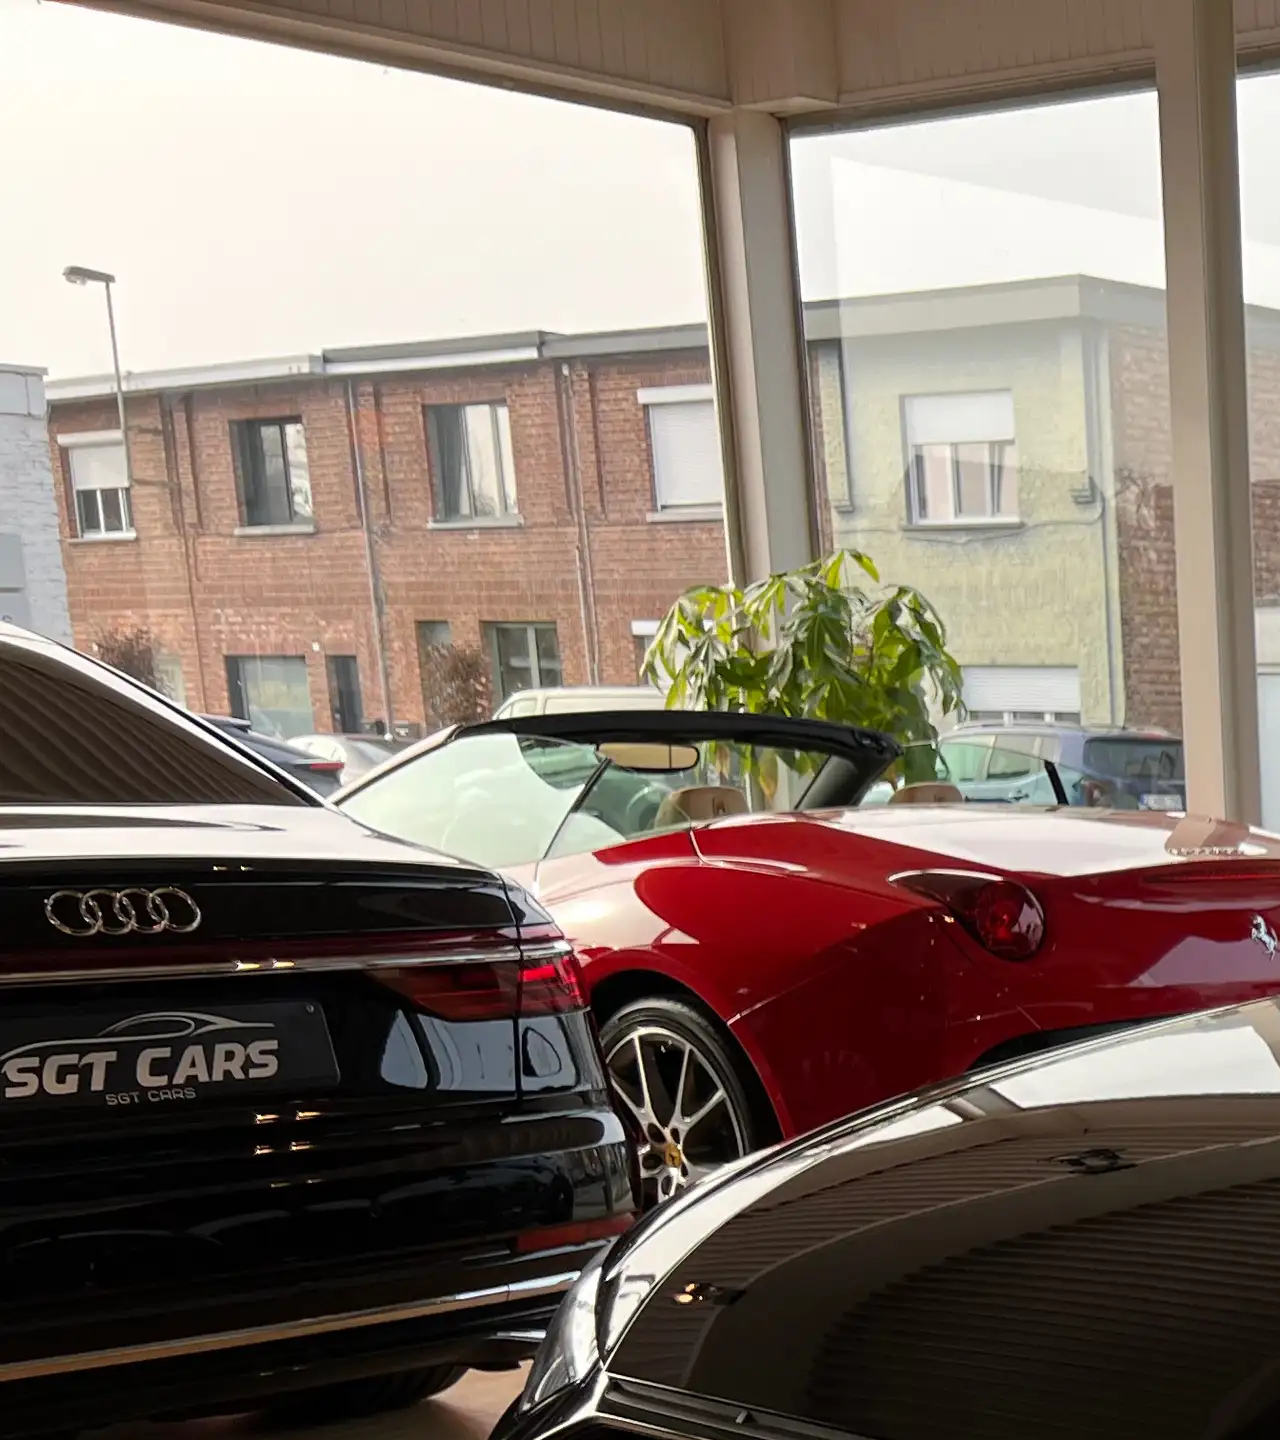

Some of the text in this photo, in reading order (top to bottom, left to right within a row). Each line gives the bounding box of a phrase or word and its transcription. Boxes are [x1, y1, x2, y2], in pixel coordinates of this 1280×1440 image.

[1, 1039, 279, 1098] SGT CARS
[105, 1087, 196, 1106] SGT CARS
